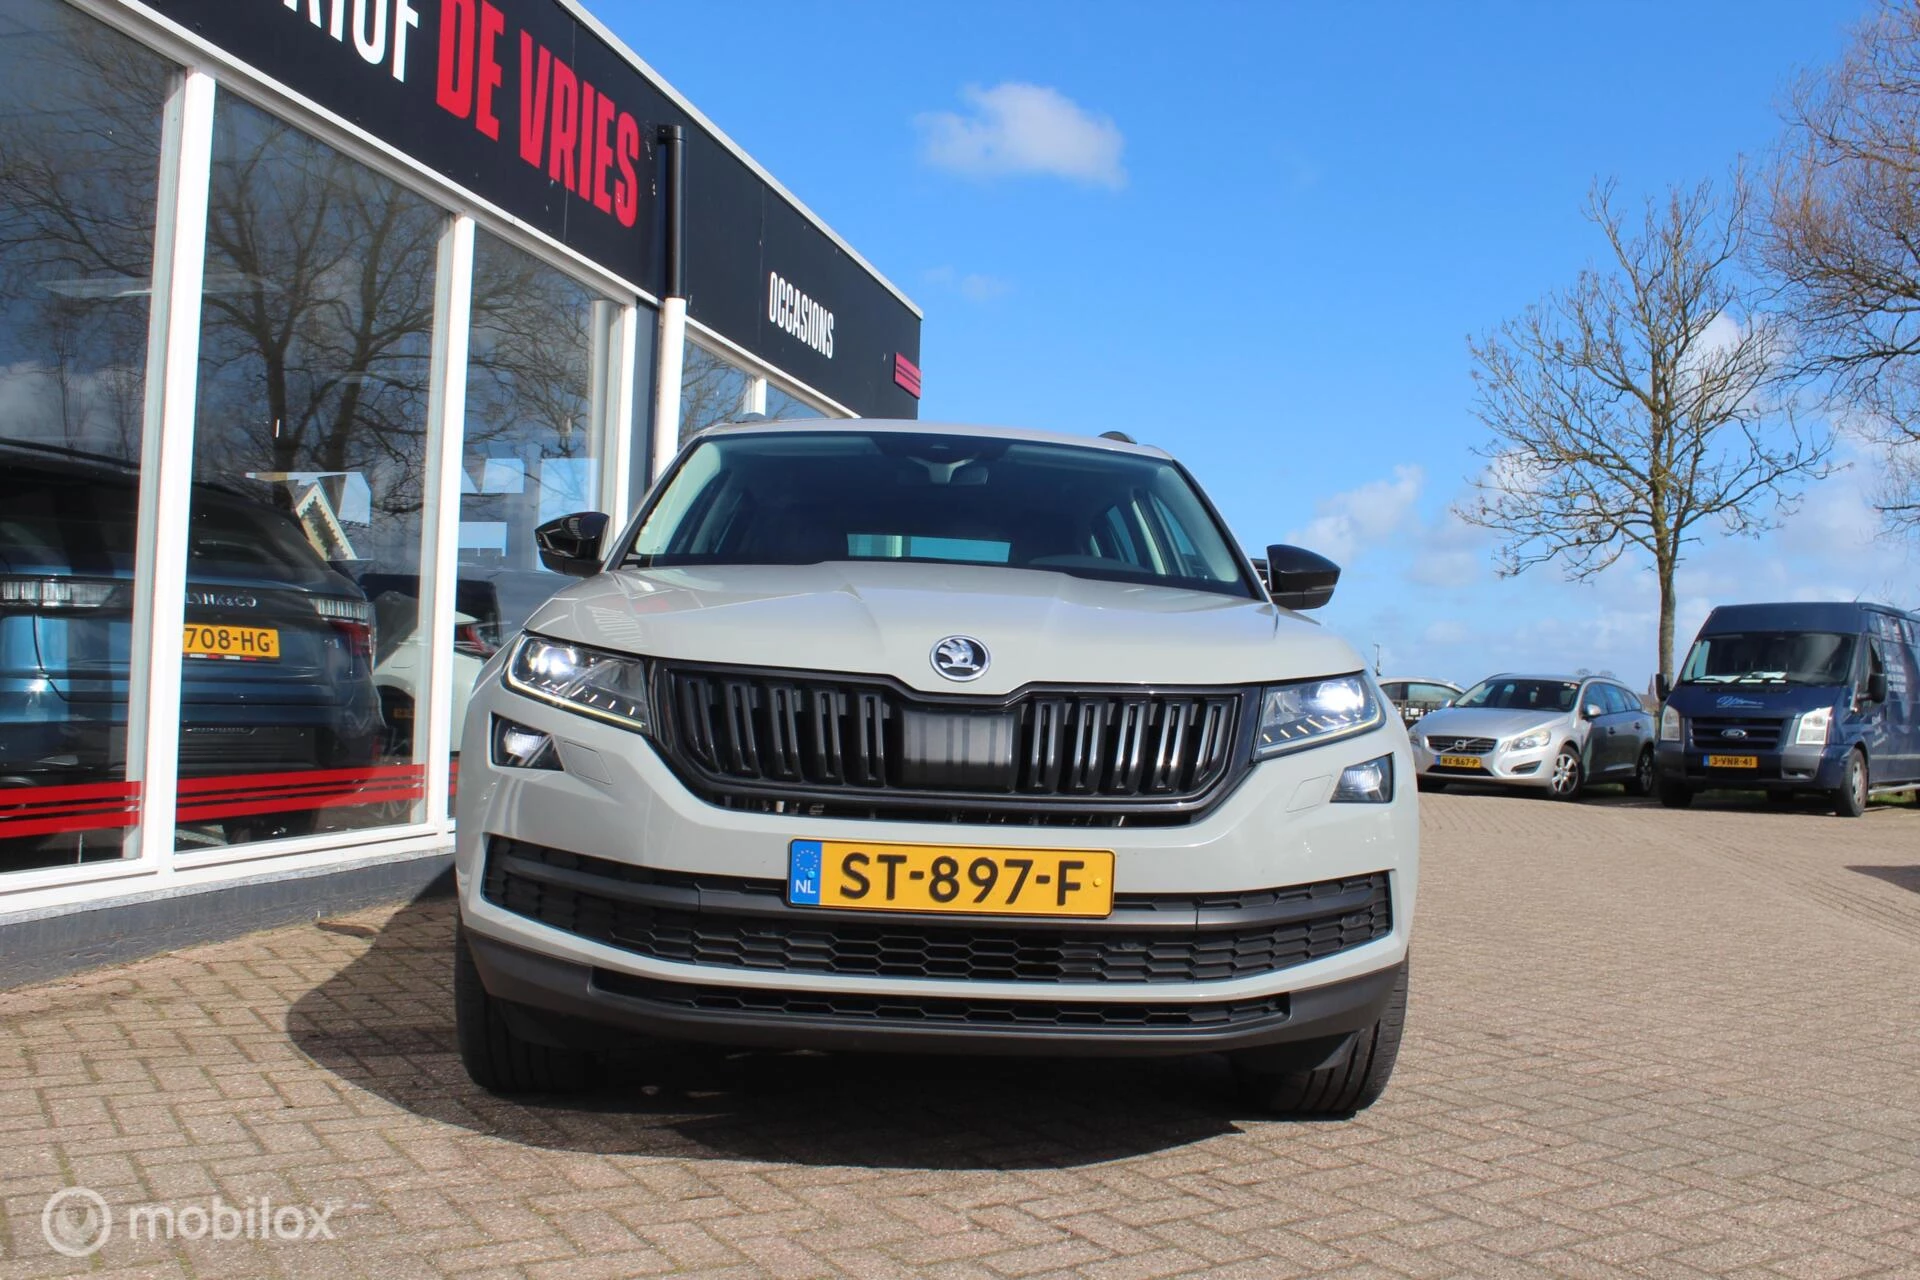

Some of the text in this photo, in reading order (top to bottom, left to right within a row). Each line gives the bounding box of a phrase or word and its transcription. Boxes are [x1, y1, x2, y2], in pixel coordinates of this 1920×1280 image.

[436, 0, 504, 142] DE
[519, 28, 641, 229] VRIES
[768, 271, 834, 359] OCCASIONS
[795, 878, 817, 894] NL
[839, 851, 1085, 906] ST-897-F
